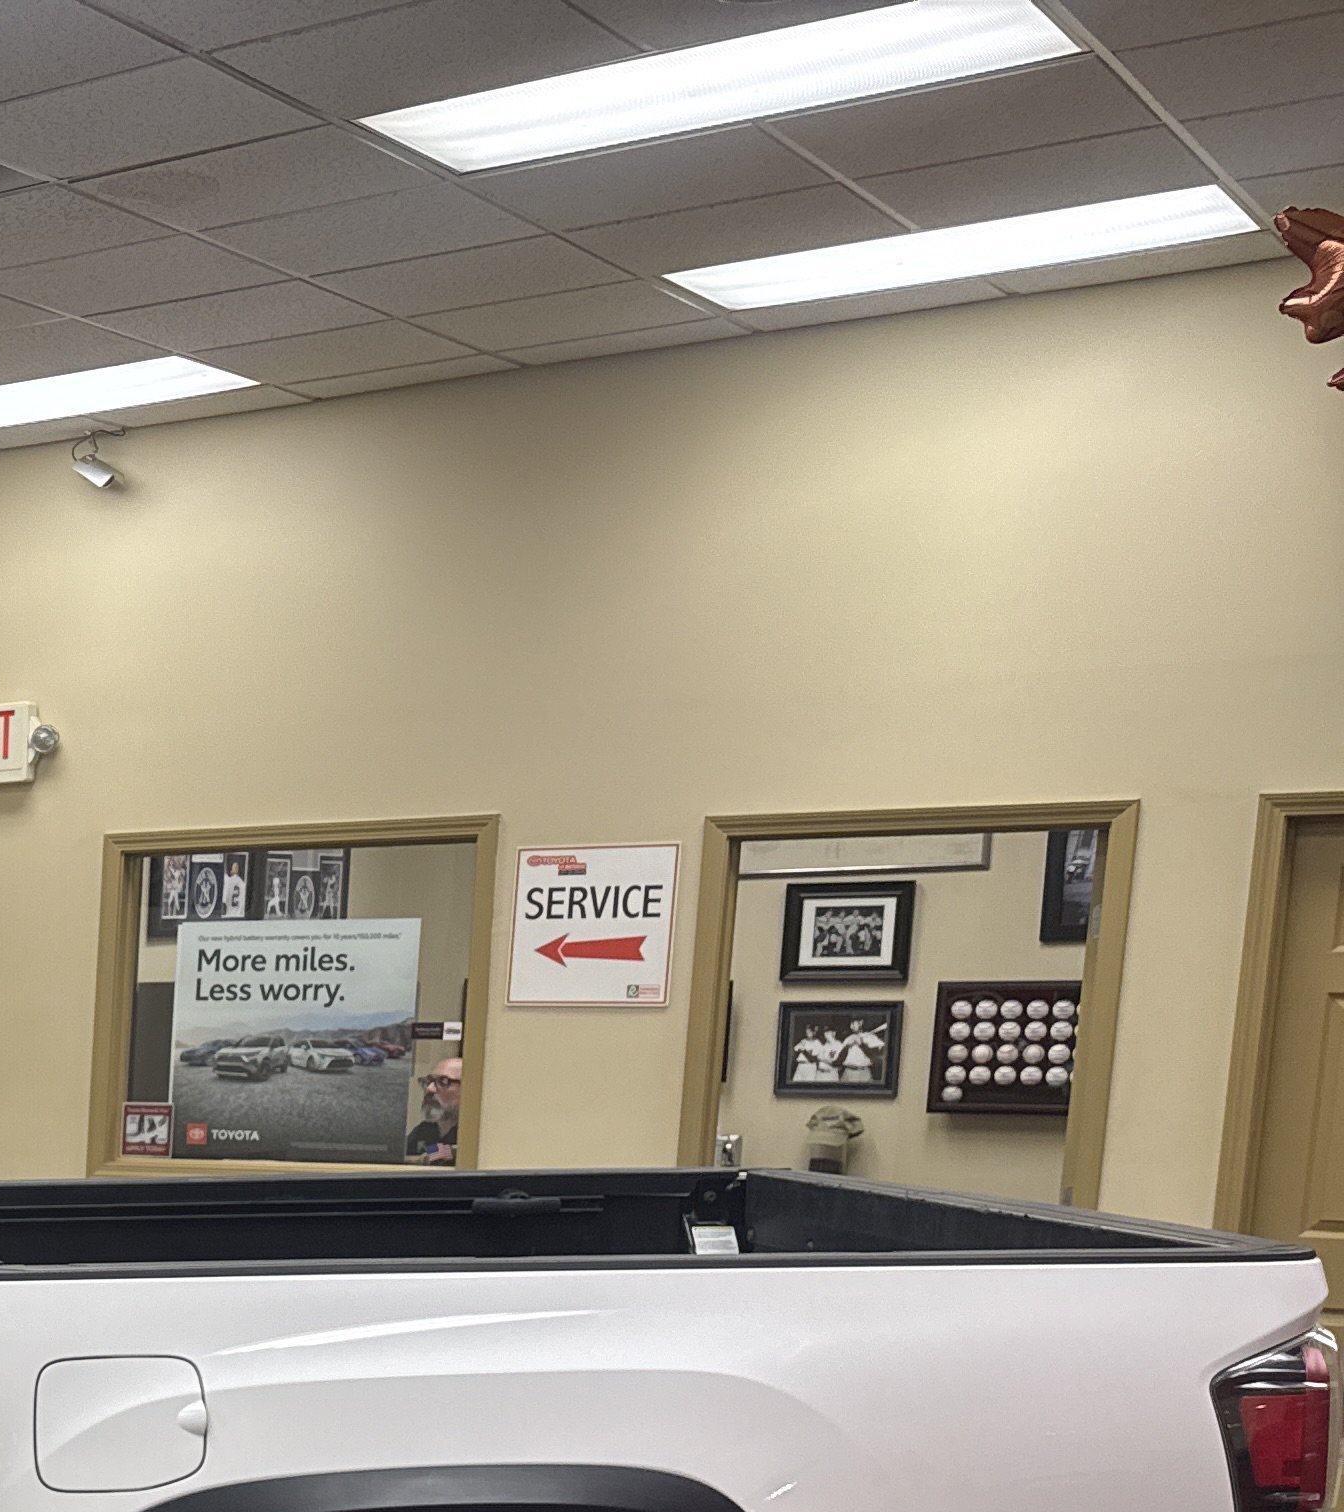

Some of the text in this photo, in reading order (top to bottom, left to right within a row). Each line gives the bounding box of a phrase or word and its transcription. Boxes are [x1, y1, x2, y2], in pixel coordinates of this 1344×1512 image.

[524, 884, 664, 921] SERVICE
[196, 946, 355, 973] More miles.
[195, 977, 345, 1009] Less worry.
[210, 1128, 260, 1142] TOYOTA
